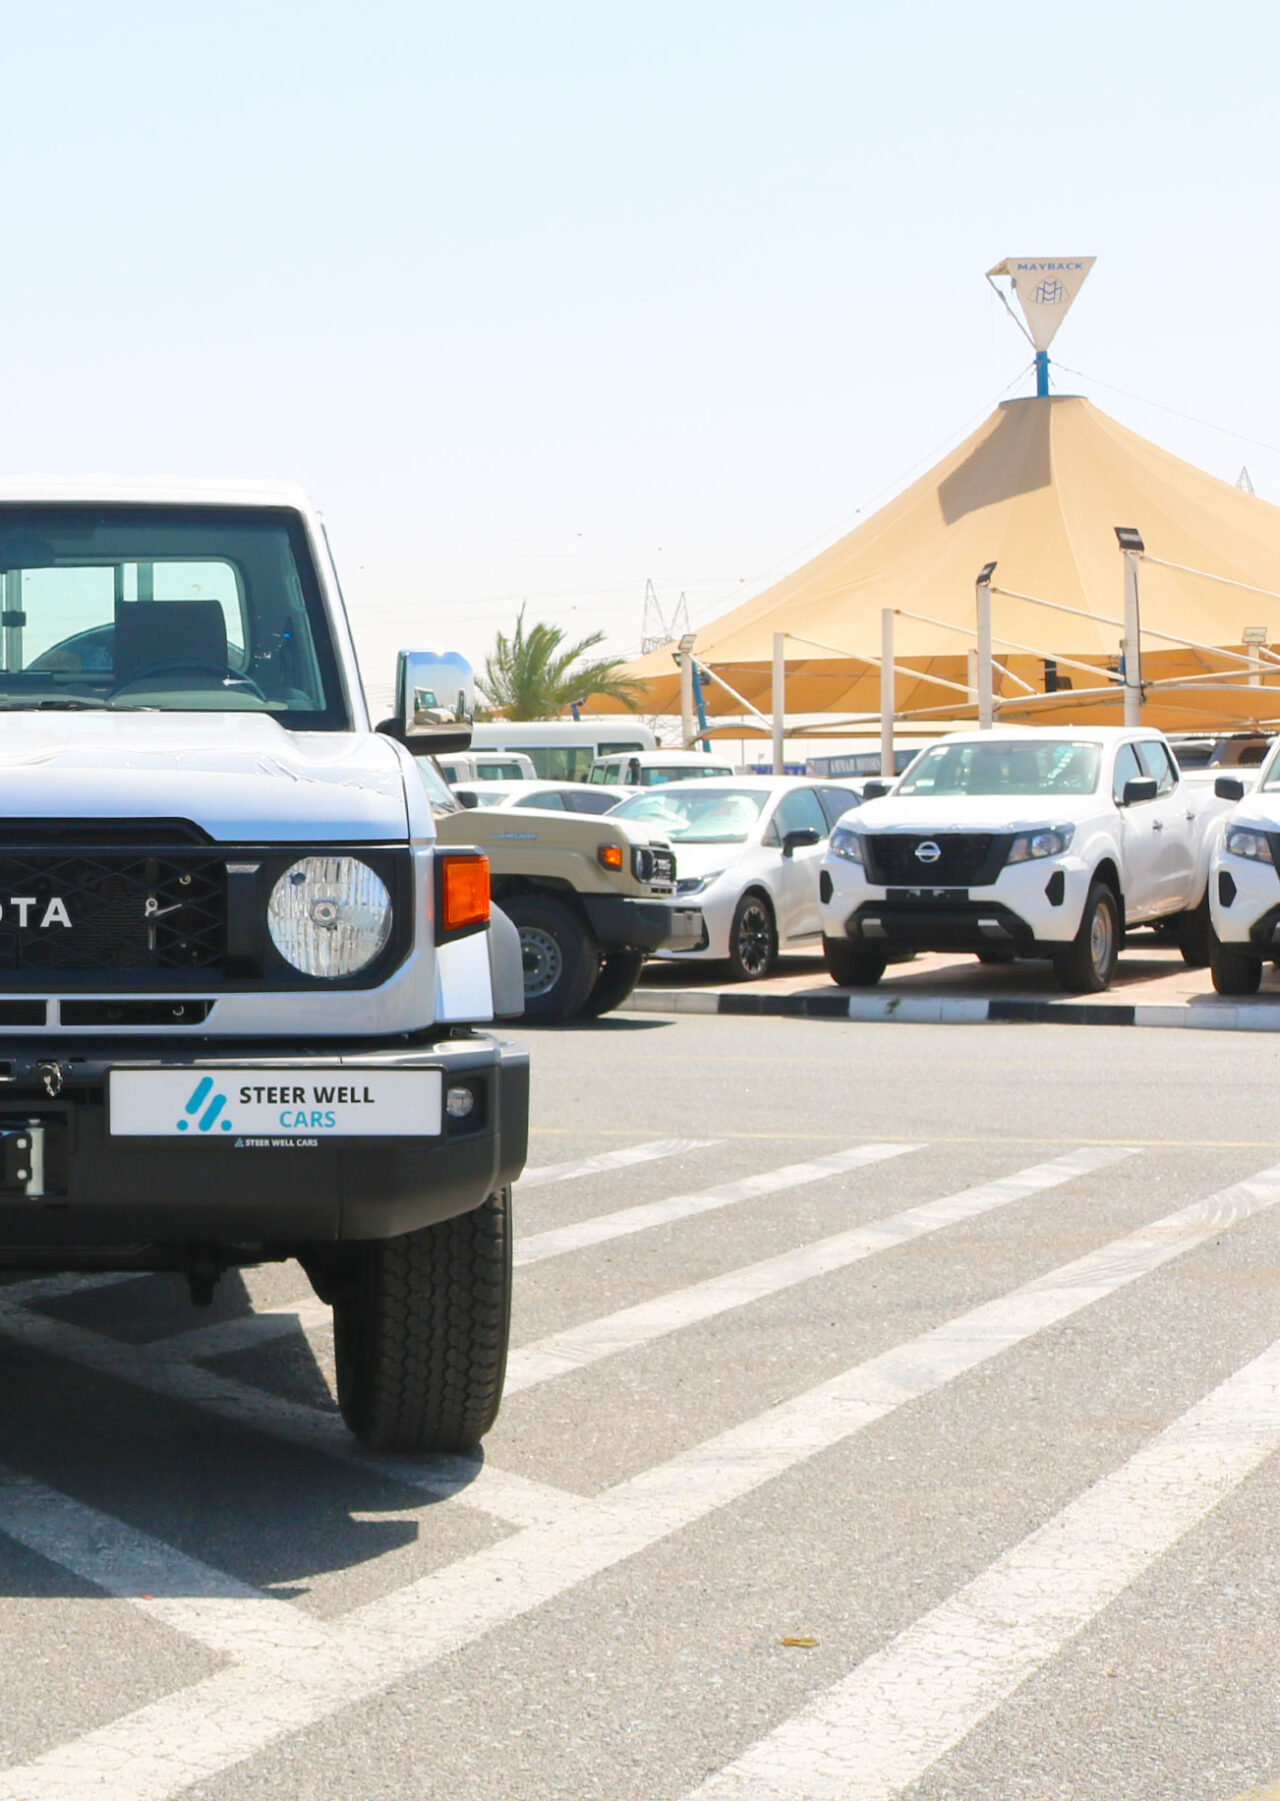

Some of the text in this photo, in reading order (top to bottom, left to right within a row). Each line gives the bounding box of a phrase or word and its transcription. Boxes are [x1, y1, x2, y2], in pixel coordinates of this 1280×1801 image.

[1017, 262, 1083, 271] MAYBACK
[240, 1086, 375, 1104] STEER WELL
[279, 1110, 336, 1128] CARS
[245, 1139, 318, 1147] STEER WELL CARS
